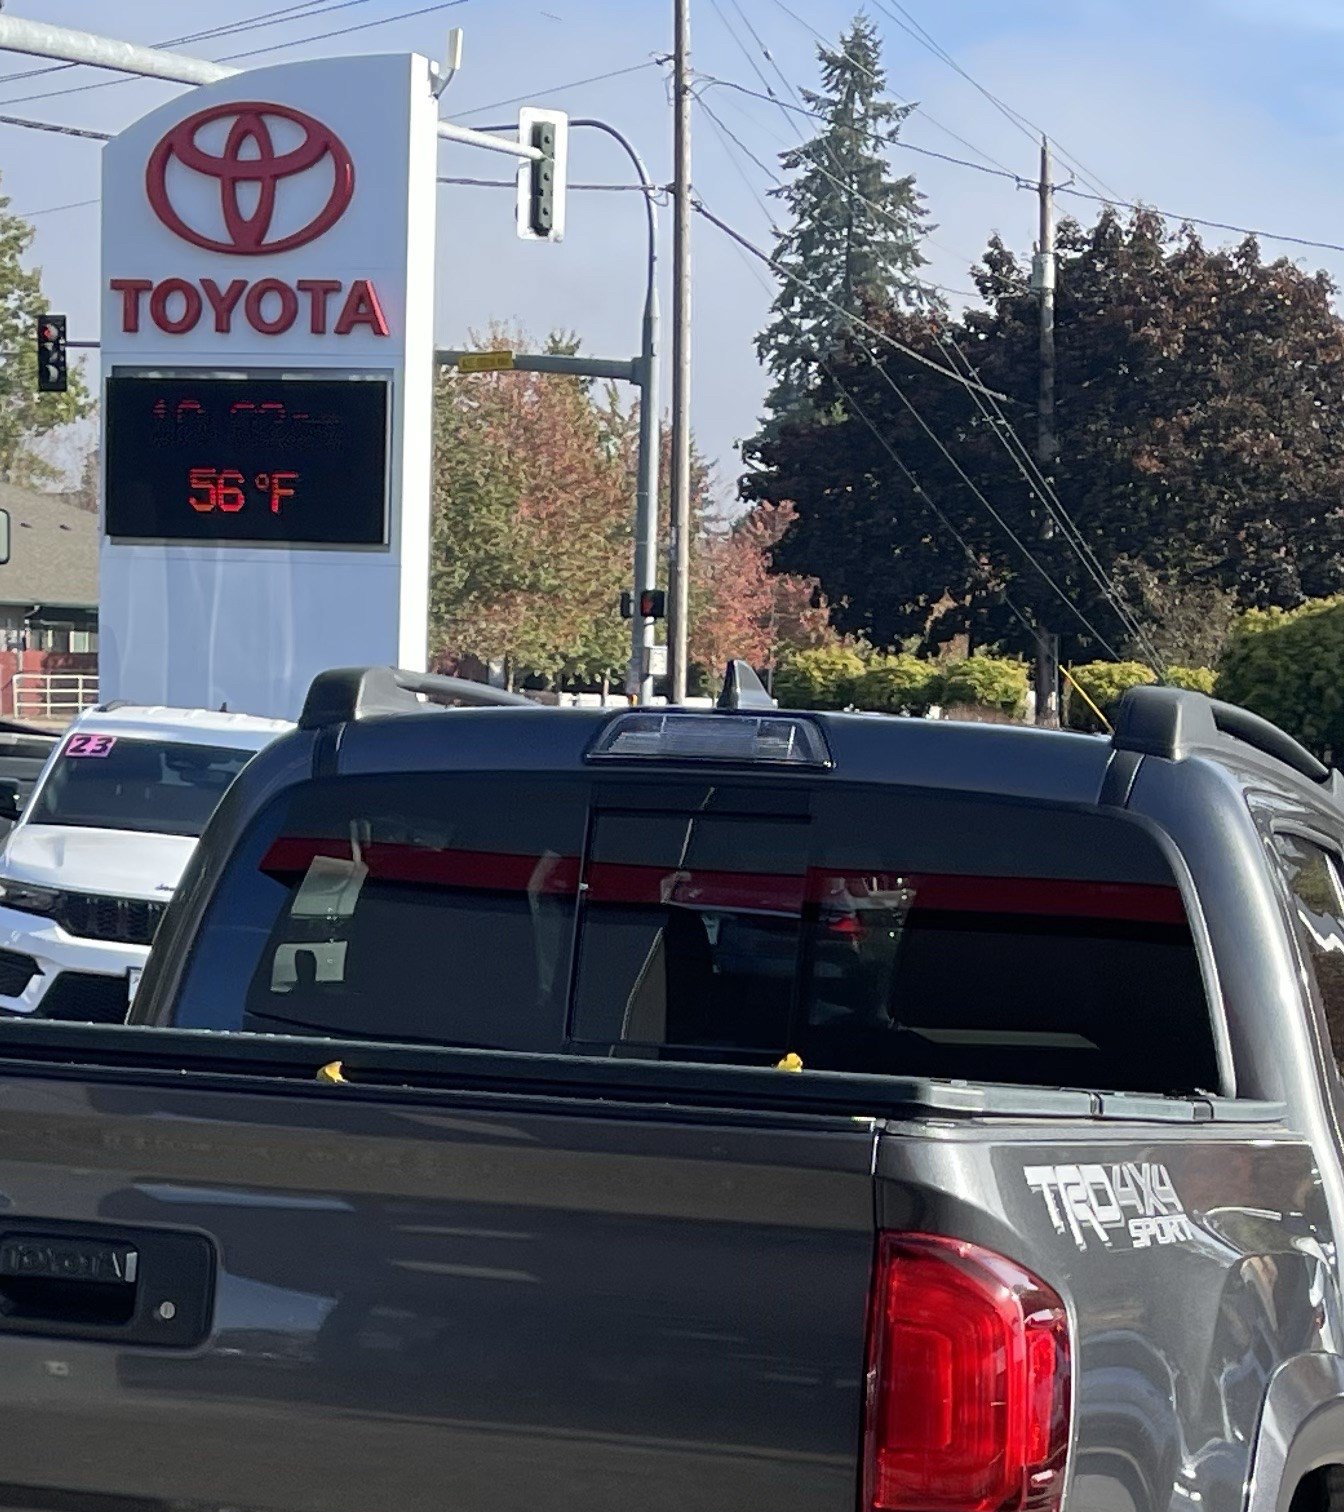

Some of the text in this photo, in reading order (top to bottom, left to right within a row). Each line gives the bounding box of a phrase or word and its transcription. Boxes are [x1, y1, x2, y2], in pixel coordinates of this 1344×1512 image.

[109, 277, 391, 337] TOYOTA
[68, 736, 113, 754] 23
[1023, 1164, 1125, 1251] TRD
[1128, 1213, 1194, 1249] SPORT
